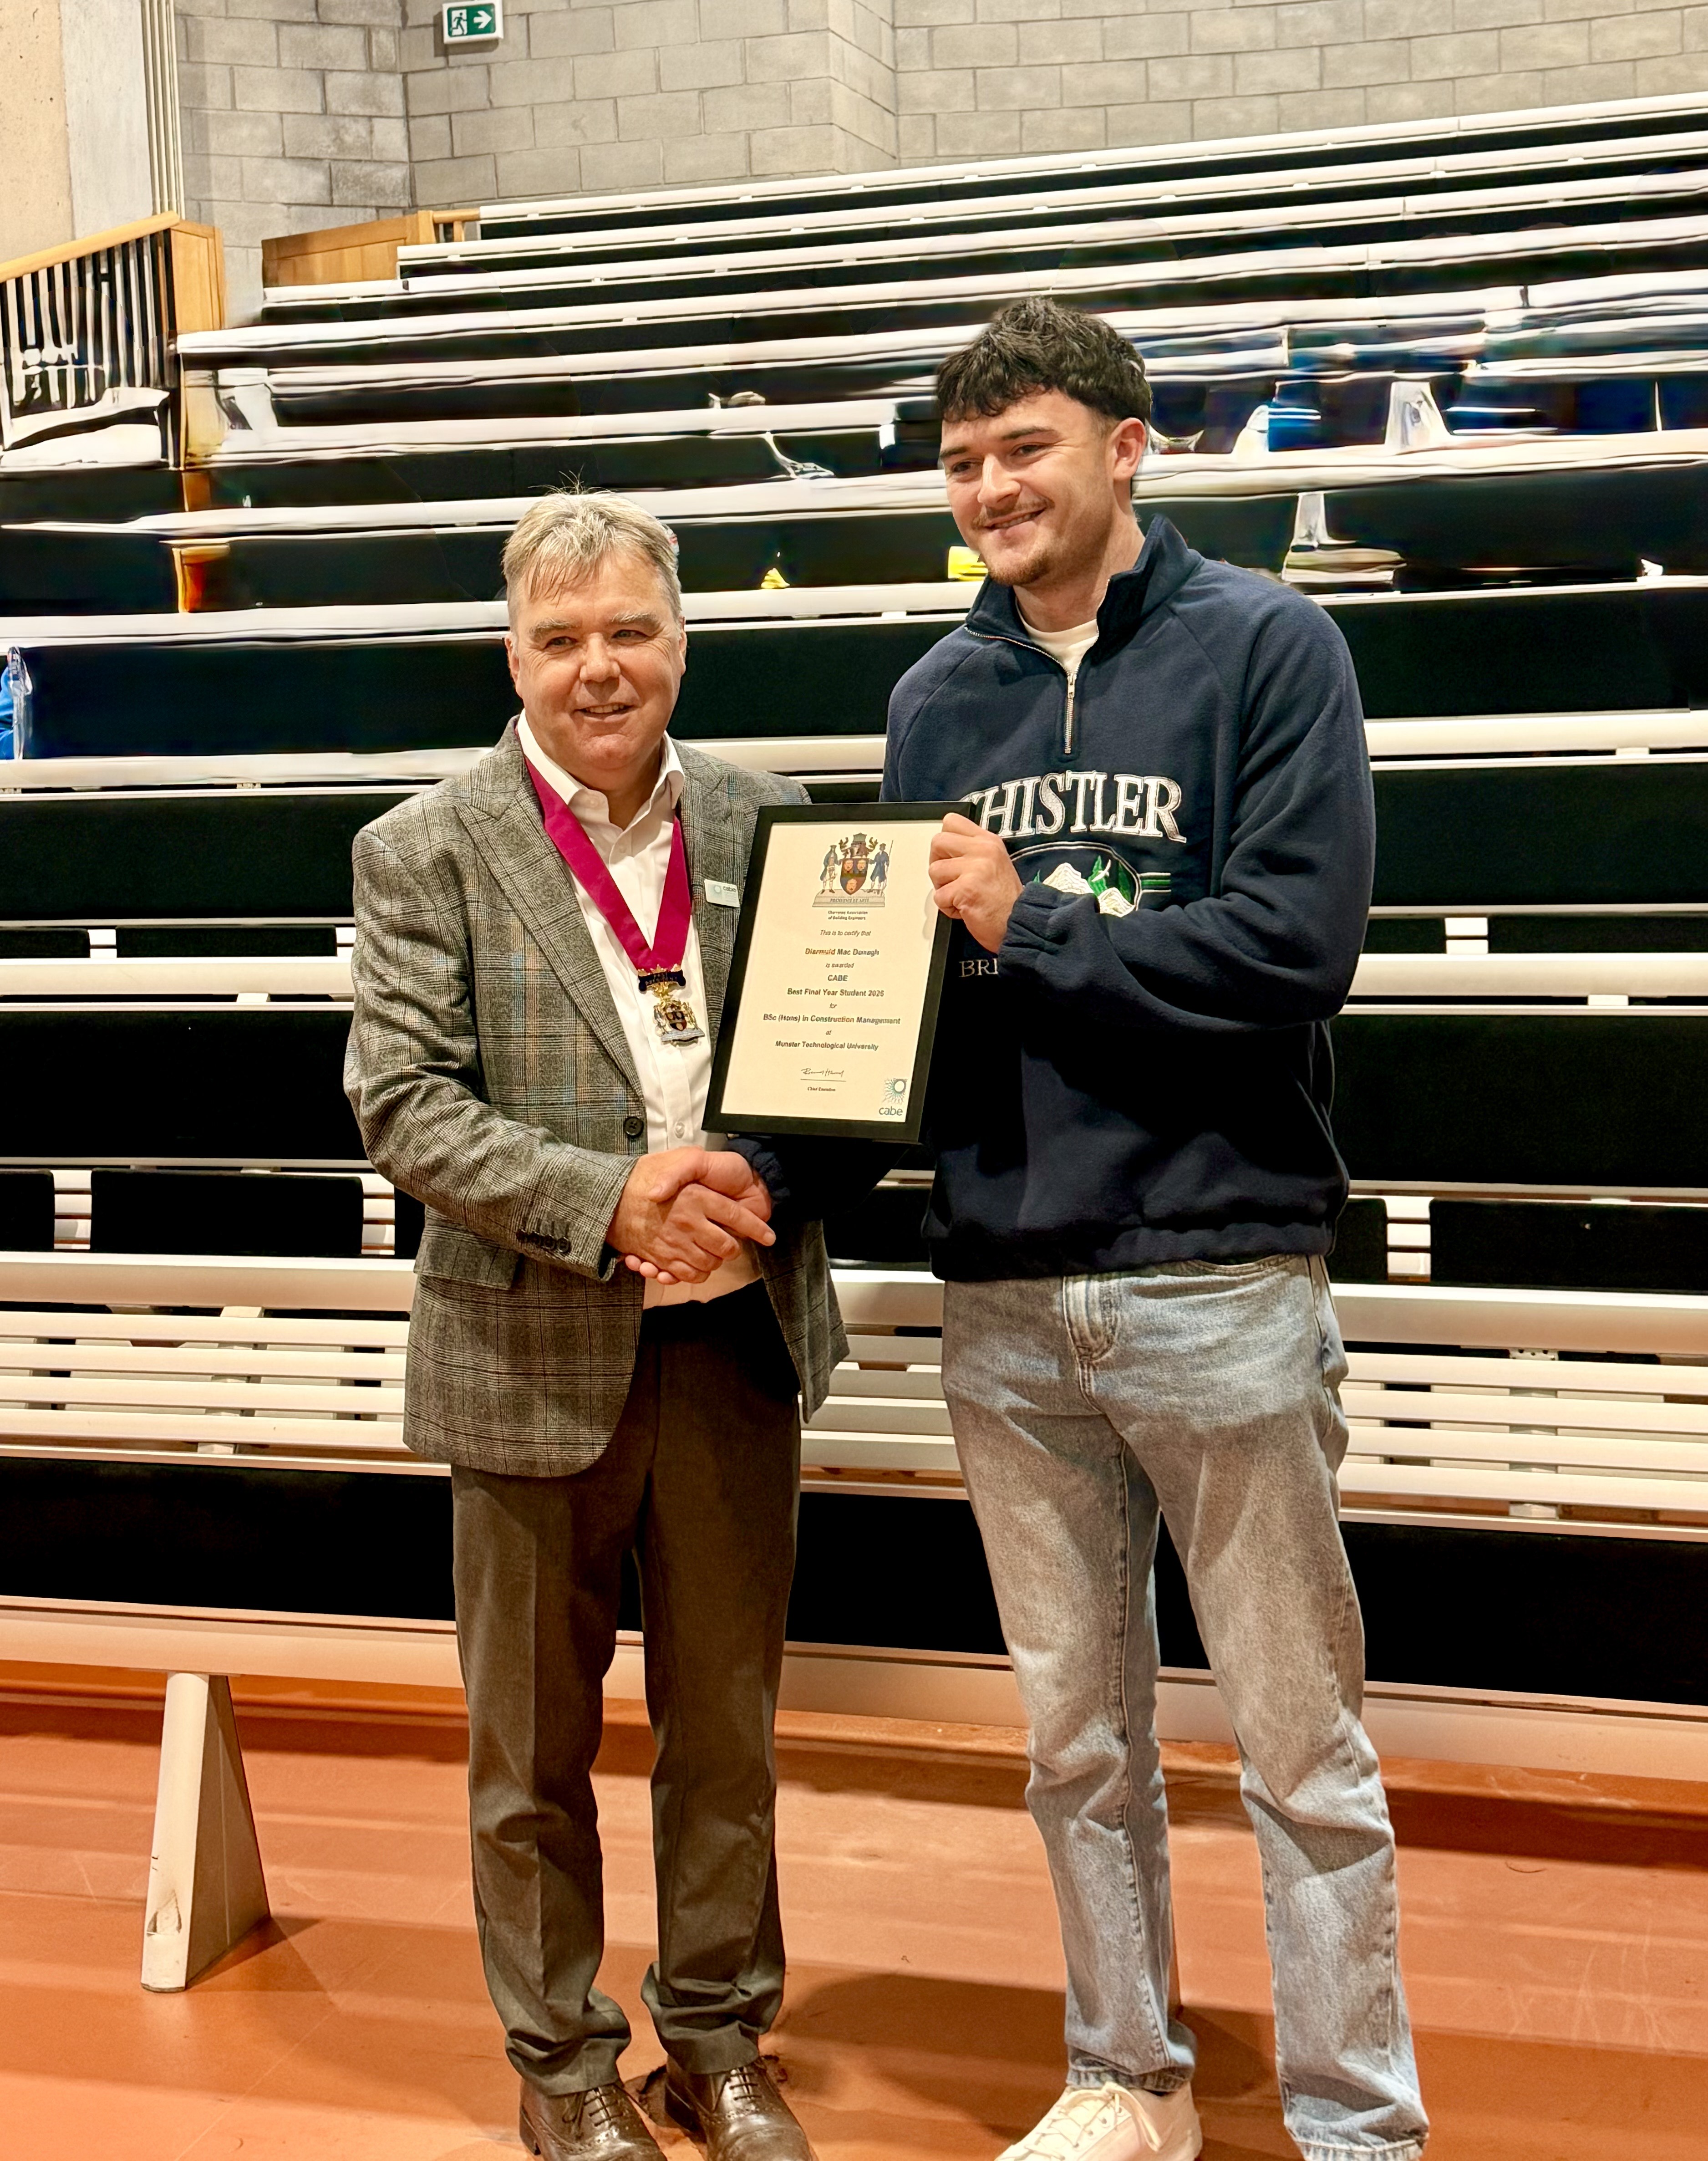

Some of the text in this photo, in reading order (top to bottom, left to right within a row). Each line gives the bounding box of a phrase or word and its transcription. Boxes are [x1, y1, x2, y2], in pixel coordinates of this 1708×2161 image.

[959, 770, 1187, 843] HISTLER
[856, 1016, 901, 1025] Management
[802, 1041, 845, 1050] Technological
[847, 1042, 879, 1051] University
[879, 1106, 903, 1116] cabe
